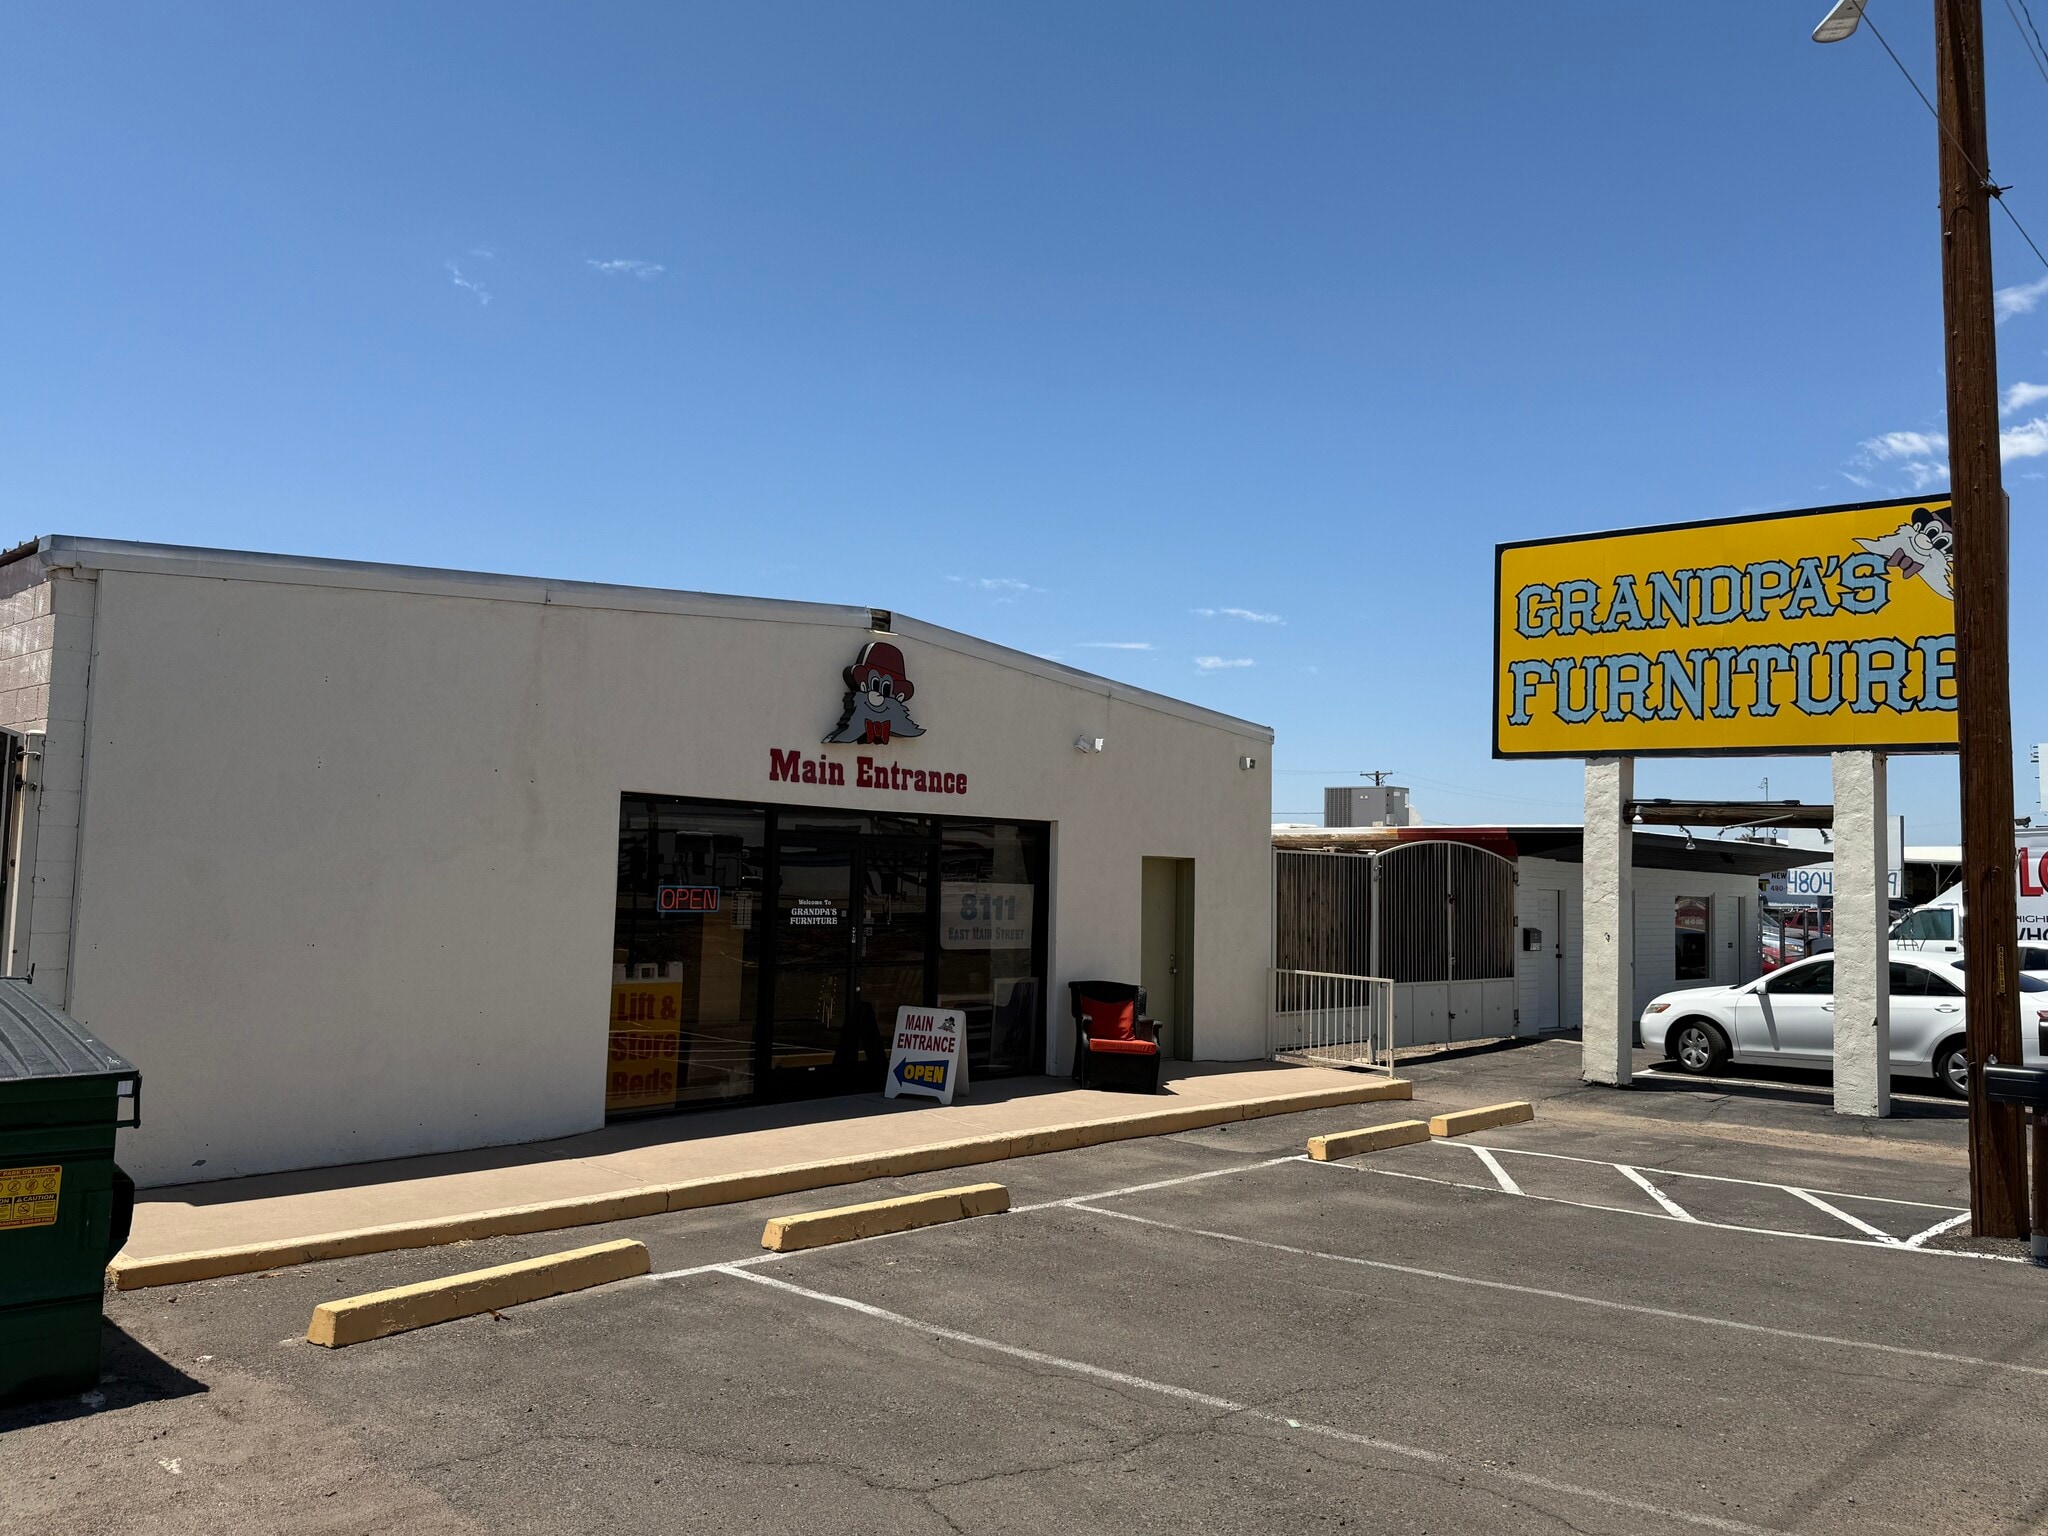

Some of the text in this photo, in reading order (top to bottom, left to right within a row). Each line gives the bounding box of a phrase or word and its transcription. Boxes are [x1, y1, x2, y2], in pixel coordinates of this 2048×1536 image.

[1514, 551, 1892, 639] GRANDPA'S
[1507, 633, 1959, 726] FURNITURE
[768, 748, 968, 795] Main Entrance
[660, 888, 717, 910] OPEN
[960, 893, 1016, 921] 8111
[790, 917, 838, 925] FURNITURE
[791, 908, 837, 916] GRANDPA'S
[948, 927, 1025, 941] EAST MAIN STREET
[616, 991, 677, 1021] Lift &
[905, 1014, 934, 1032] MAIN
[611, 1030, 678, 1062] Store
[897, 1033, 956, 1053] ENTRANCE
[610, 1067, 673, 1100] Beds
[904, 1064, 945, 1084] OPEN
[23, 1194, 55, 1202] CAUTION
